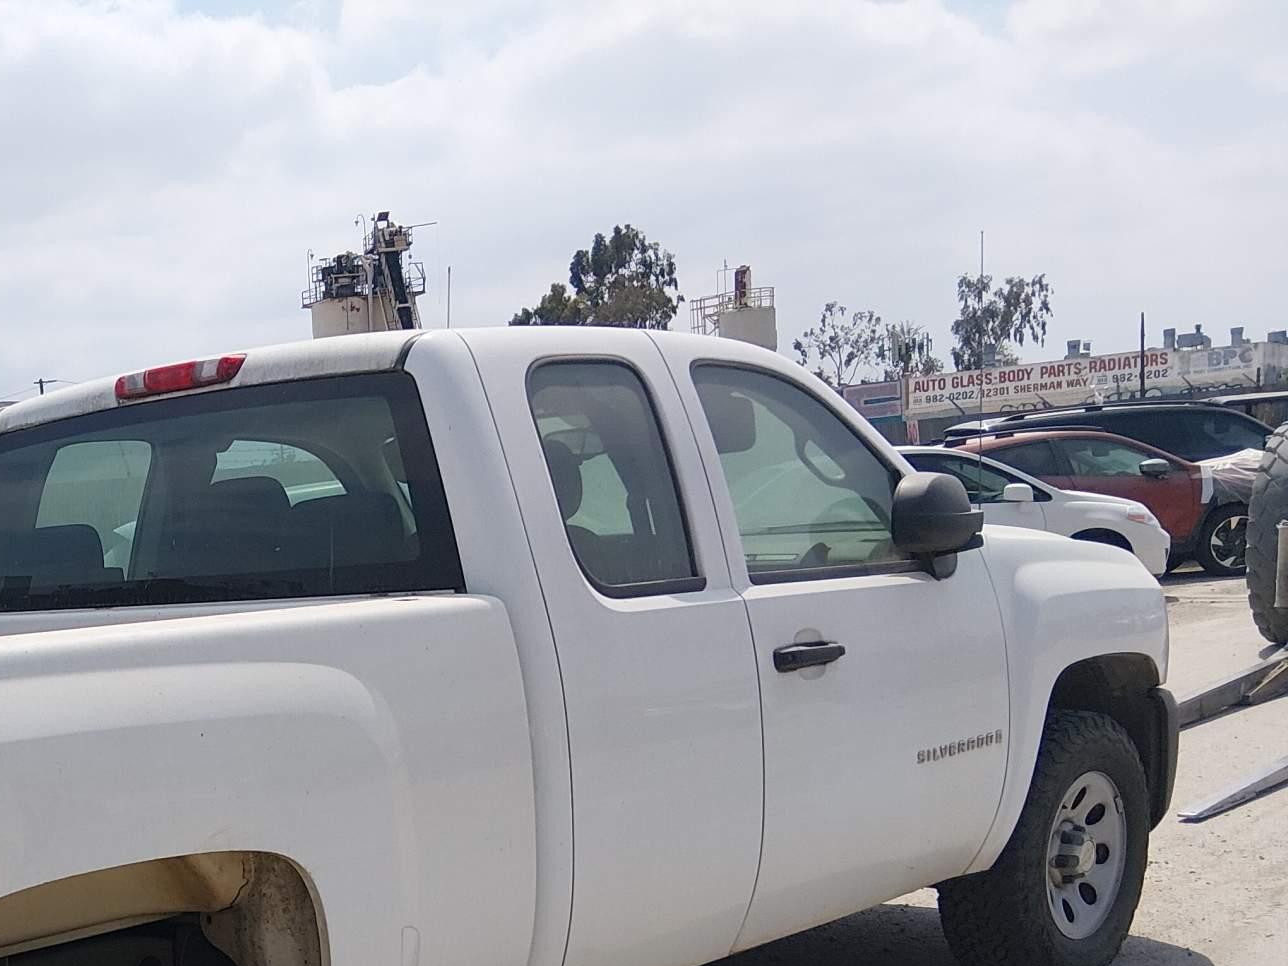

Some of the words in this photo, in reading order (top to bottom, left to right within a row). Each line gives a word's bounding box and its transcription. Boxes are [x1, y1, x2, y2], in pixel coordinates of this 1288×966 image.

[913, 378, 946, 393] AUTO
[1014, 380, 1063, 393] SHERMAN
[1112, 369, 1169, 383] 982-202
